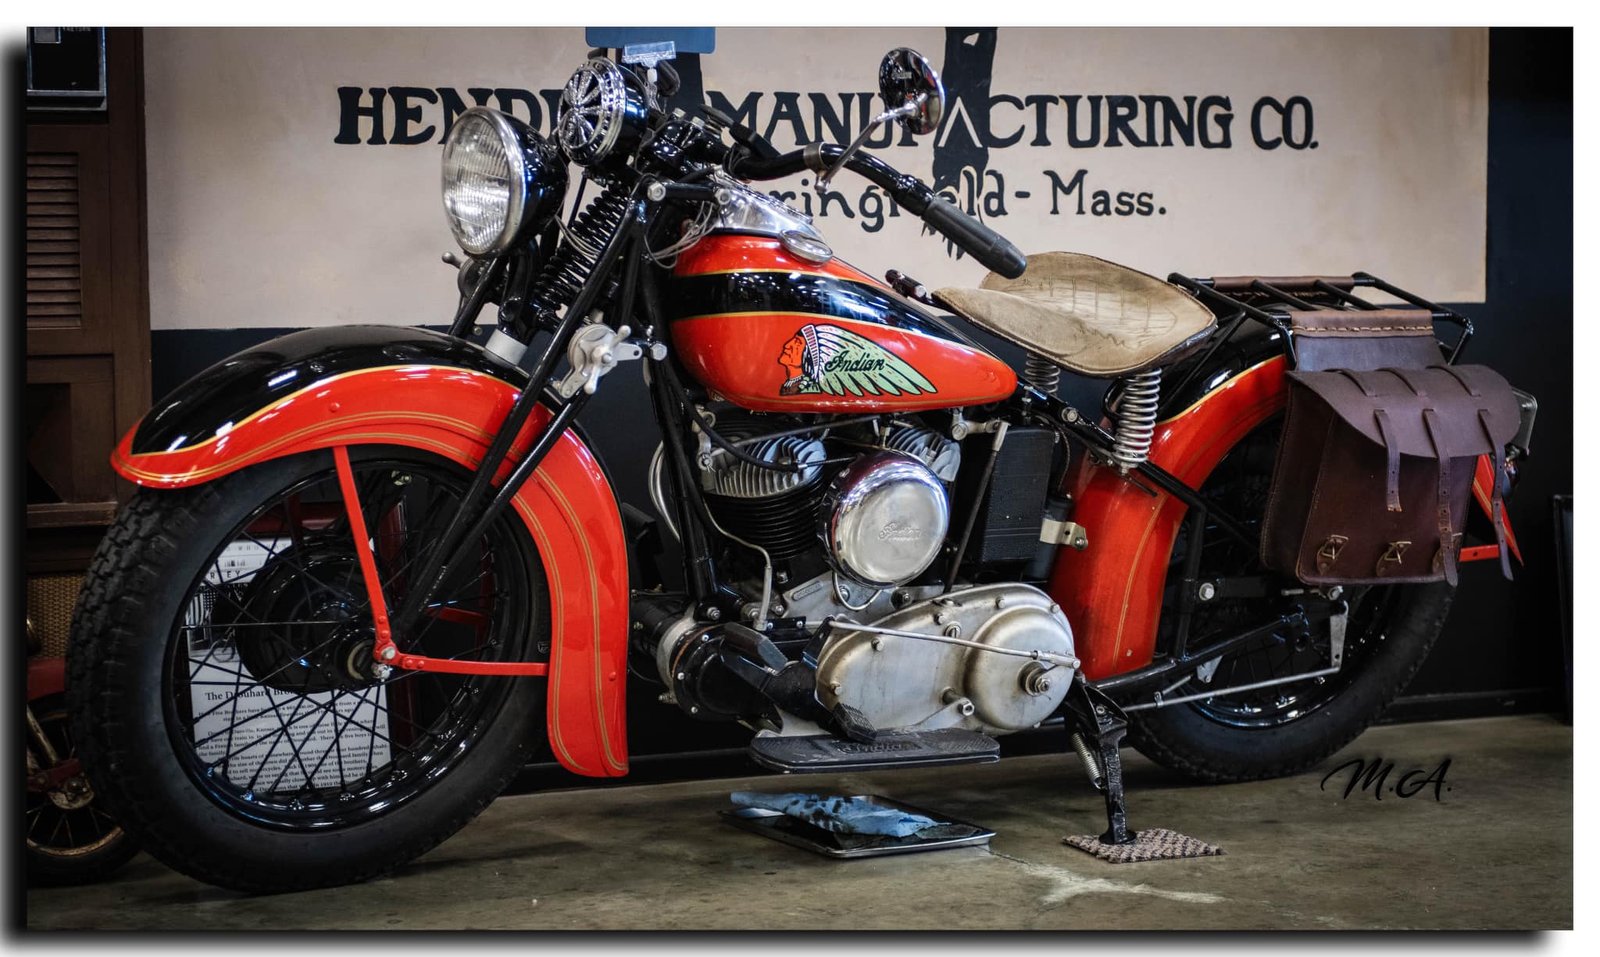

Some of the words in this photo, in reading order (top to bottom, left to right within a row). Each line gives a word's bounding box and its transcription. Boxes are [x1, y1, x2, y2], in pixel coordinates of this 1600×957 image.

[334, 86, 562, 146] HEND
[1250, 95, 1319, 150] CO.
[1042, 168, 1167, 217] Mass.
[824, 349, 886, 373] Indian
[205, 691, 224, 701] The
